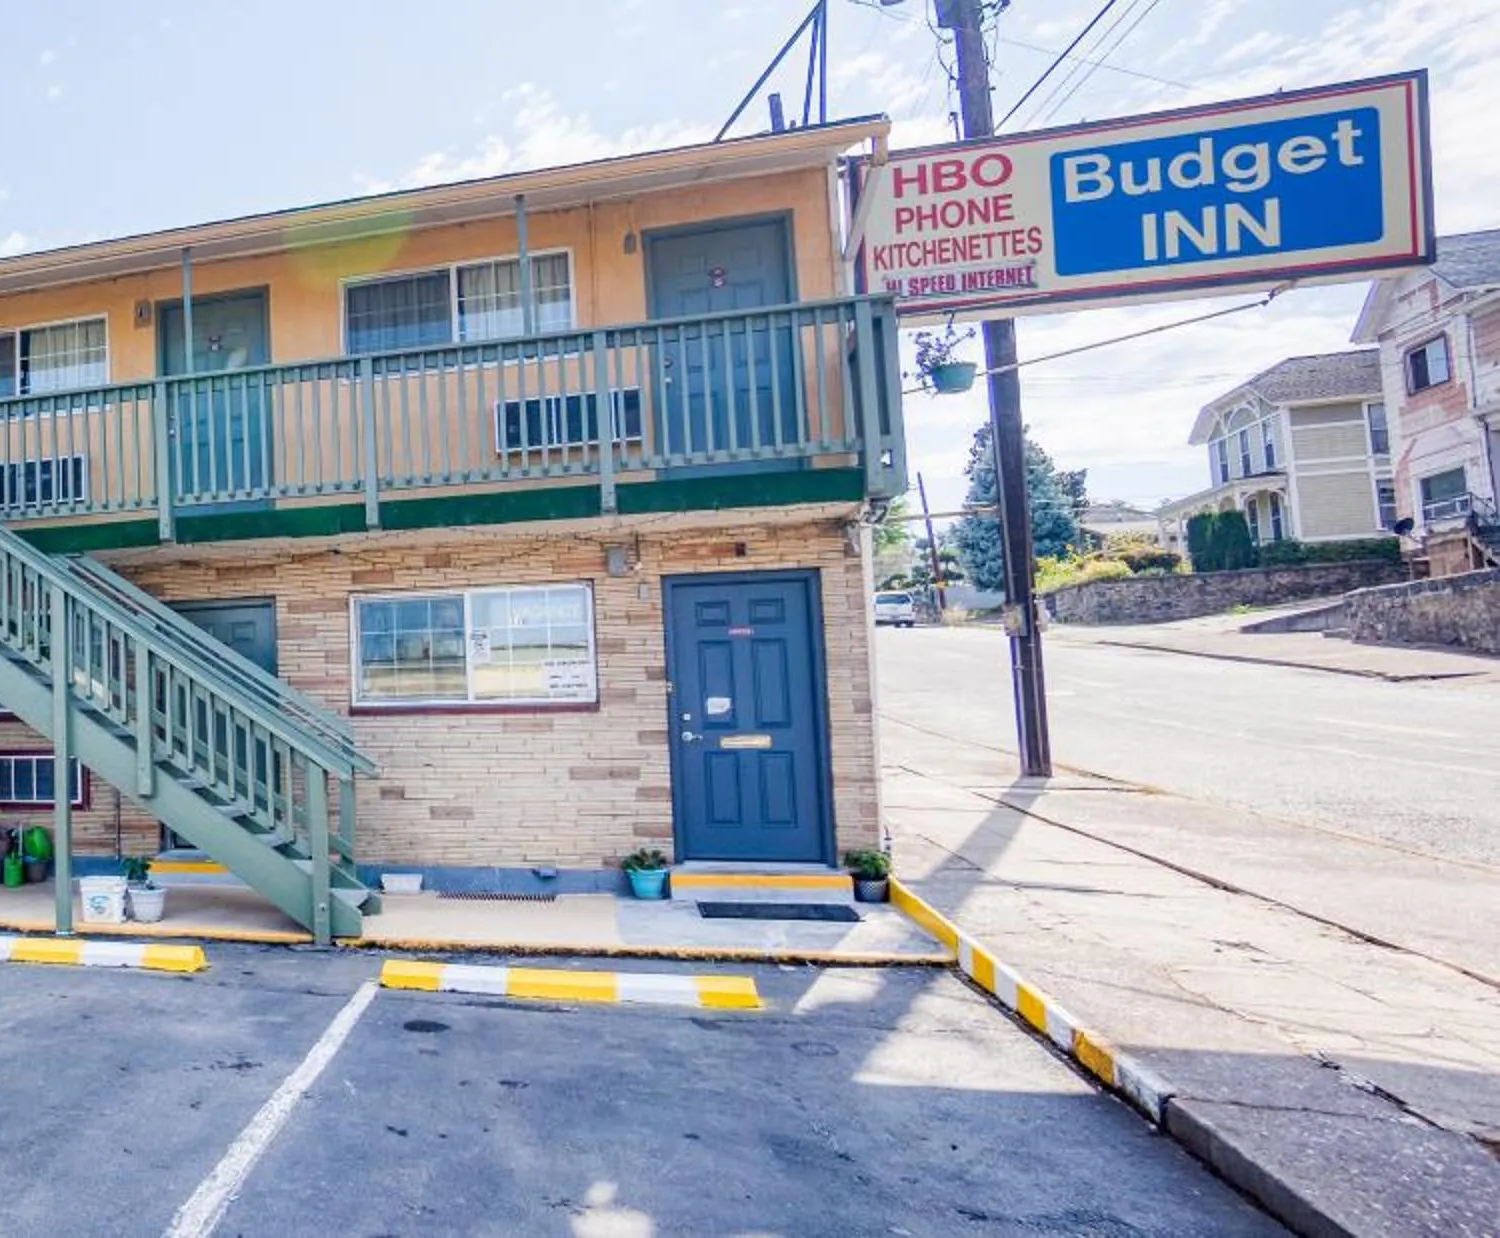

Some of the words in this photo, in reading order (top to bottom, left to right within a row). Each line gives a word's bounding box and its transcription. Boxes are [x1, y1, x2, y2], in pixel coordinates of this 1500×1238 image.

[893, 153, 1013, 198] HBO
[1063, 118, 1364, 203] Budget
[895, 194, 1015, 233] PHONE
[1142, 199, 1281, 261] INN
[873, 226, 1042, 271] KITCHENETTES
[908, 274, 955, 296] SPEED
[961, 265, 1033, 291] INTERNET
